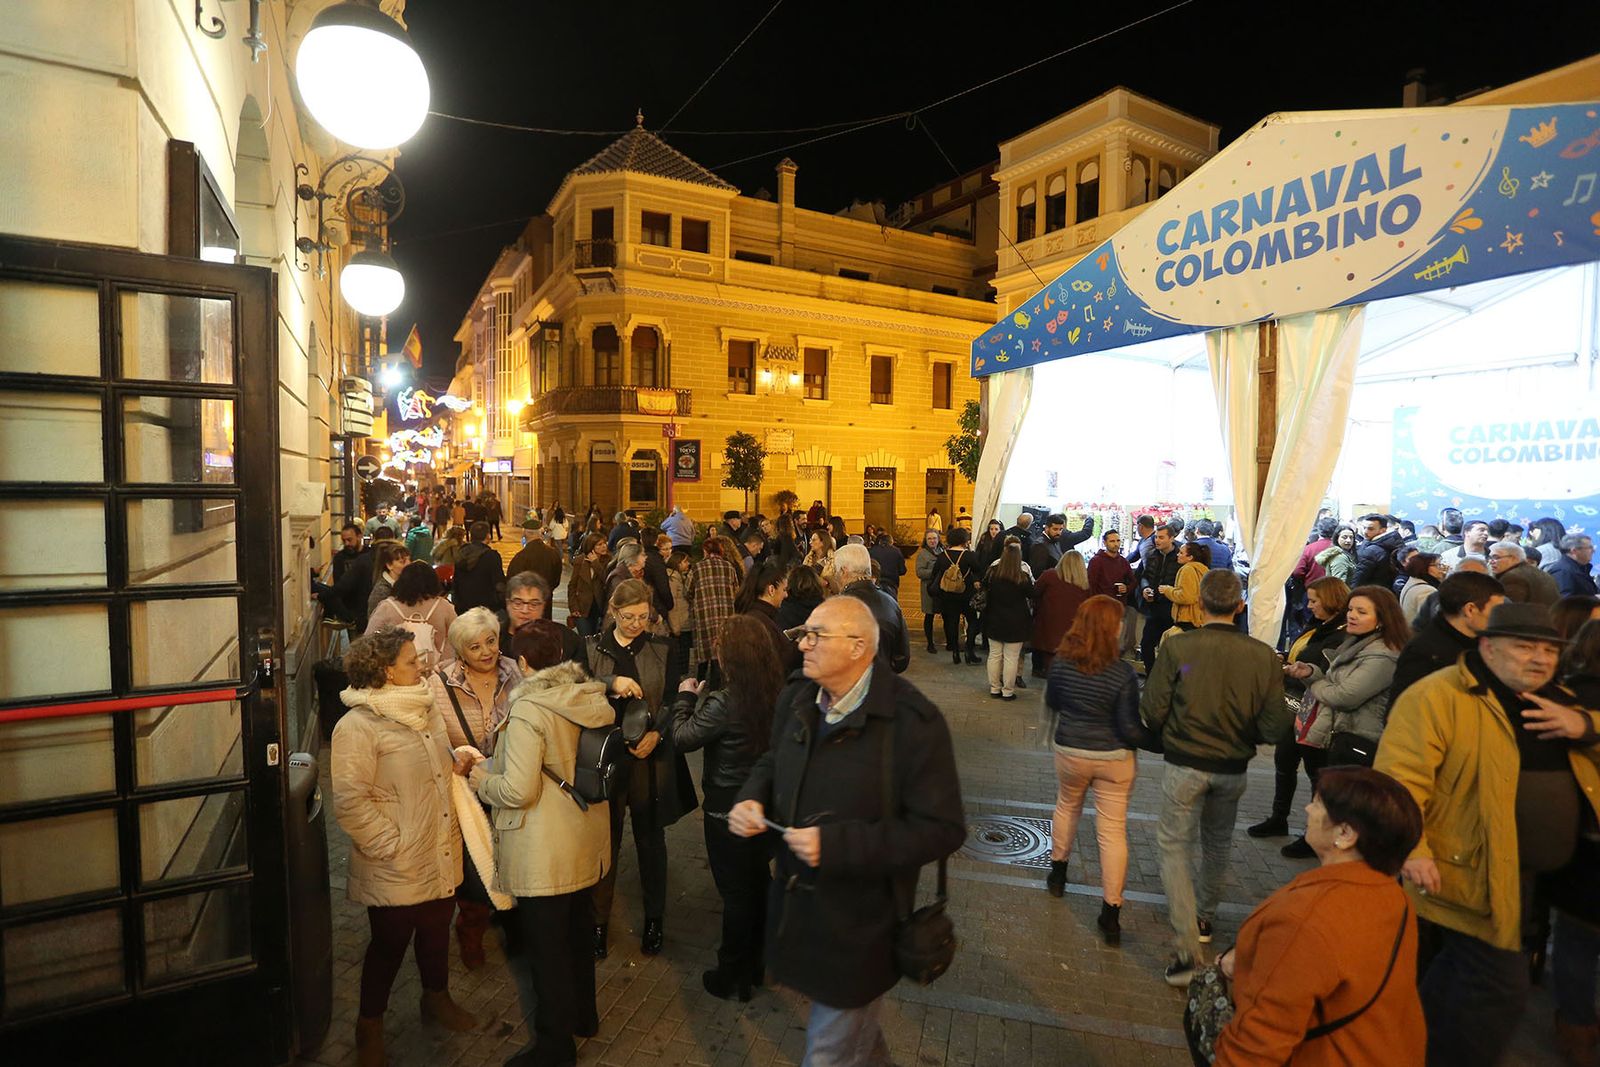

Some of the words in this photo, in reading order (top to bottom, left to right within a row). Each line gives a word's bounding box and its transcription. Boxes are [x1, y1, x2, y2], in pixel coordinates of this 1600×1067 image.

[1156, 143, 1422, 256] CARNAVAL
[1155, 193, 1422, 293] COLOMBINO
[1450, 418, 1600, 445] CARNAVA
[1449, 443, 1600, 465] COLOMBIN
[863, 480, 885, 488] asisa
